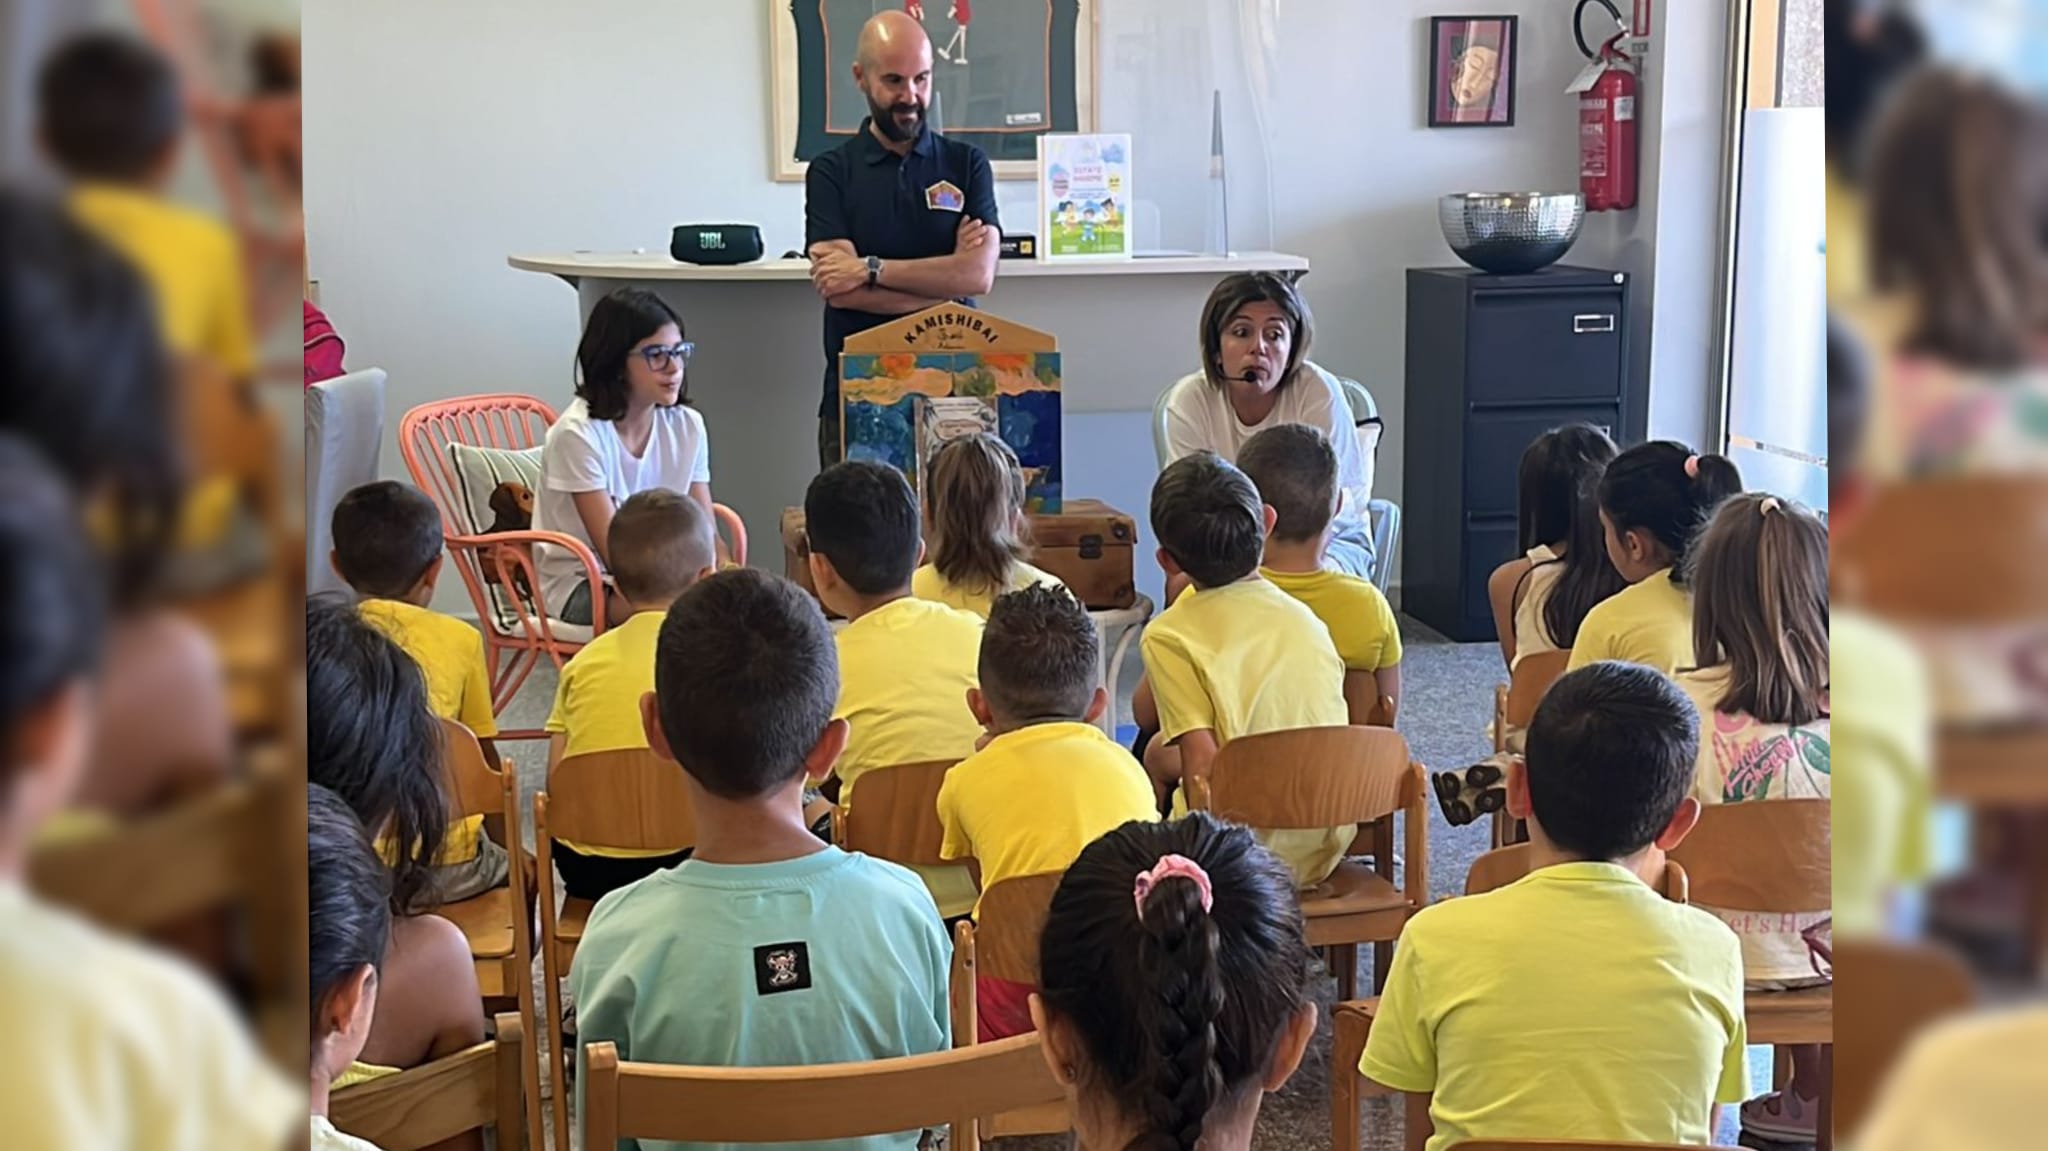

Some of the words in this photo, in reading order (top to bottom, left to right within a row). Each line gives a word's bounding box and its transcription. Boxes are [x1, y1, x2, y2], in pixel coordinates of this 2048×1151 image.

[699, 232, 726, 249] JBL
[904, 313, 999, 344] KAMISHIBAI
[1718, 912, 1770, 934] et's
